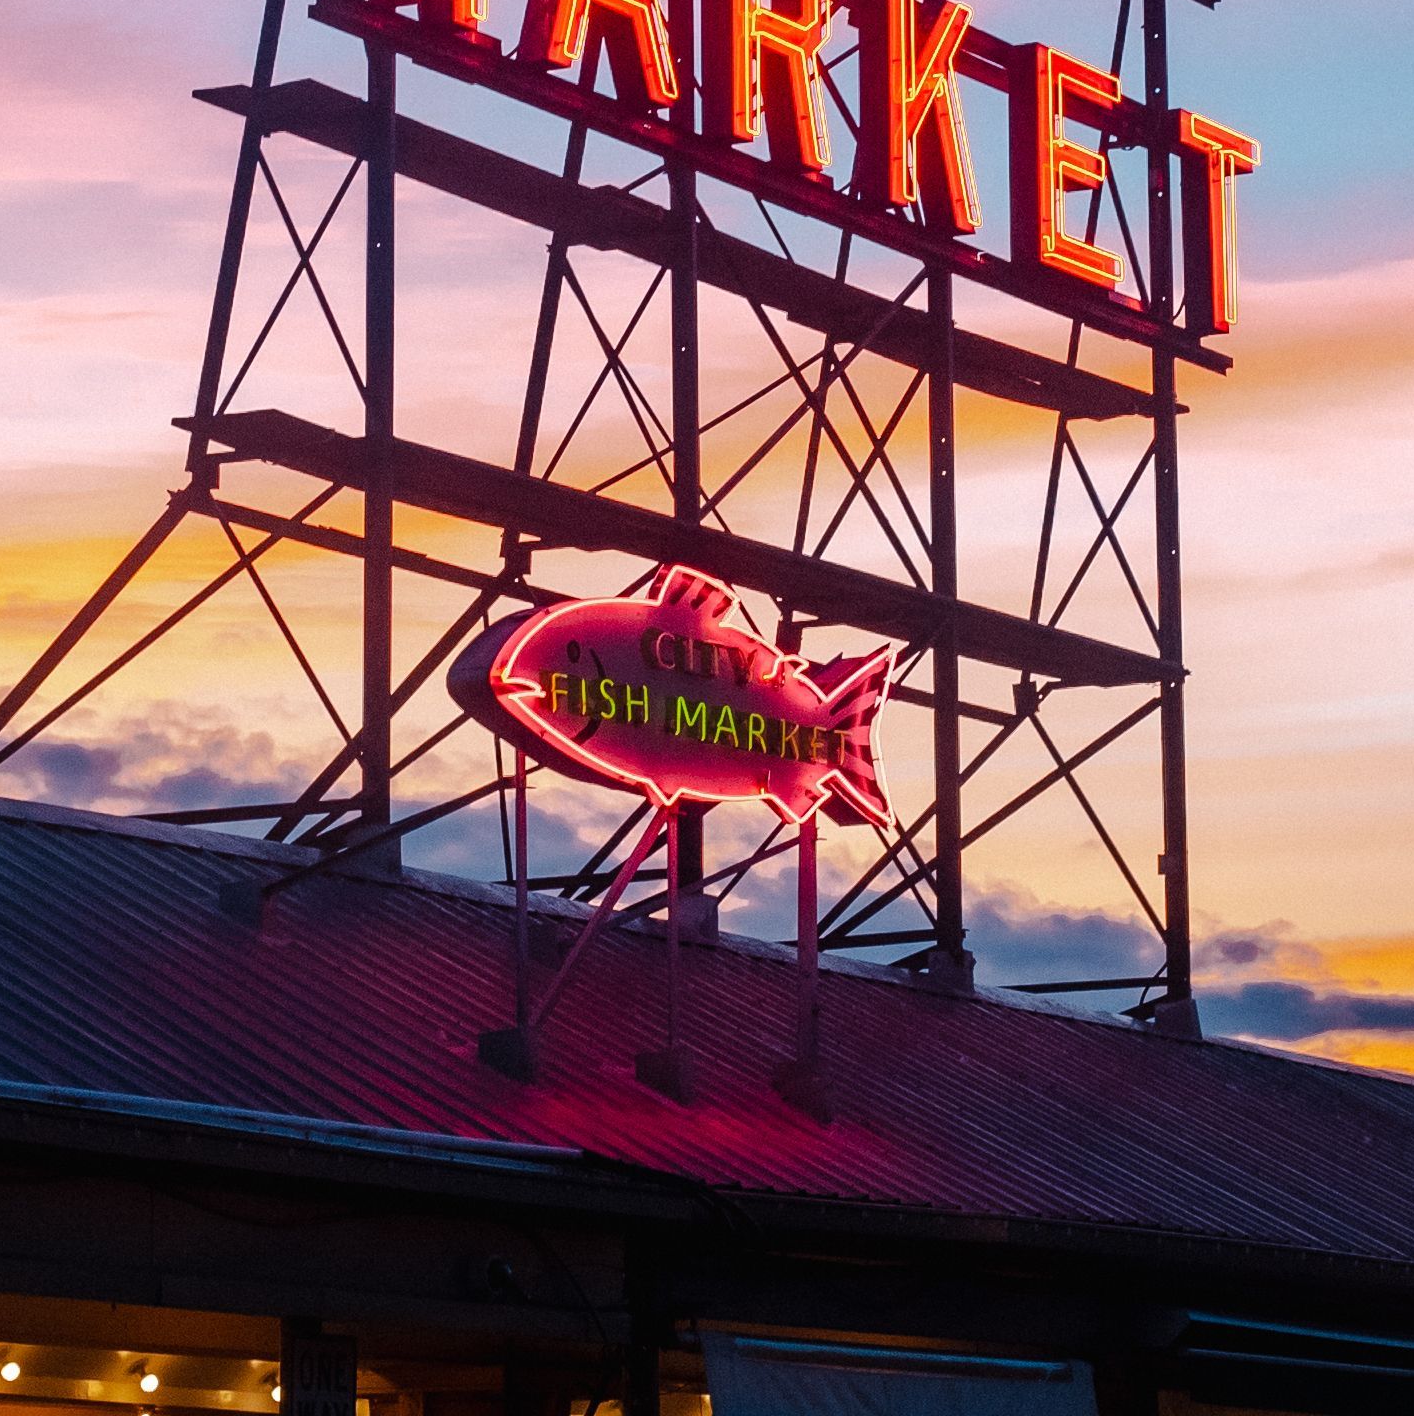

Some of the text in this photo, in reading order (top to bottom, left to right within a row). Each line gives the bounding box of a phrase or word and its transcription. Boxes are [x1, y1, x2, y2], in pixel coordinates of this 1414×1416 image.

[647, 630, 758, 685] CITY
[548, 672, 854, 767] FISH MARKET
[299, 1350, 349, 1393] ONE
